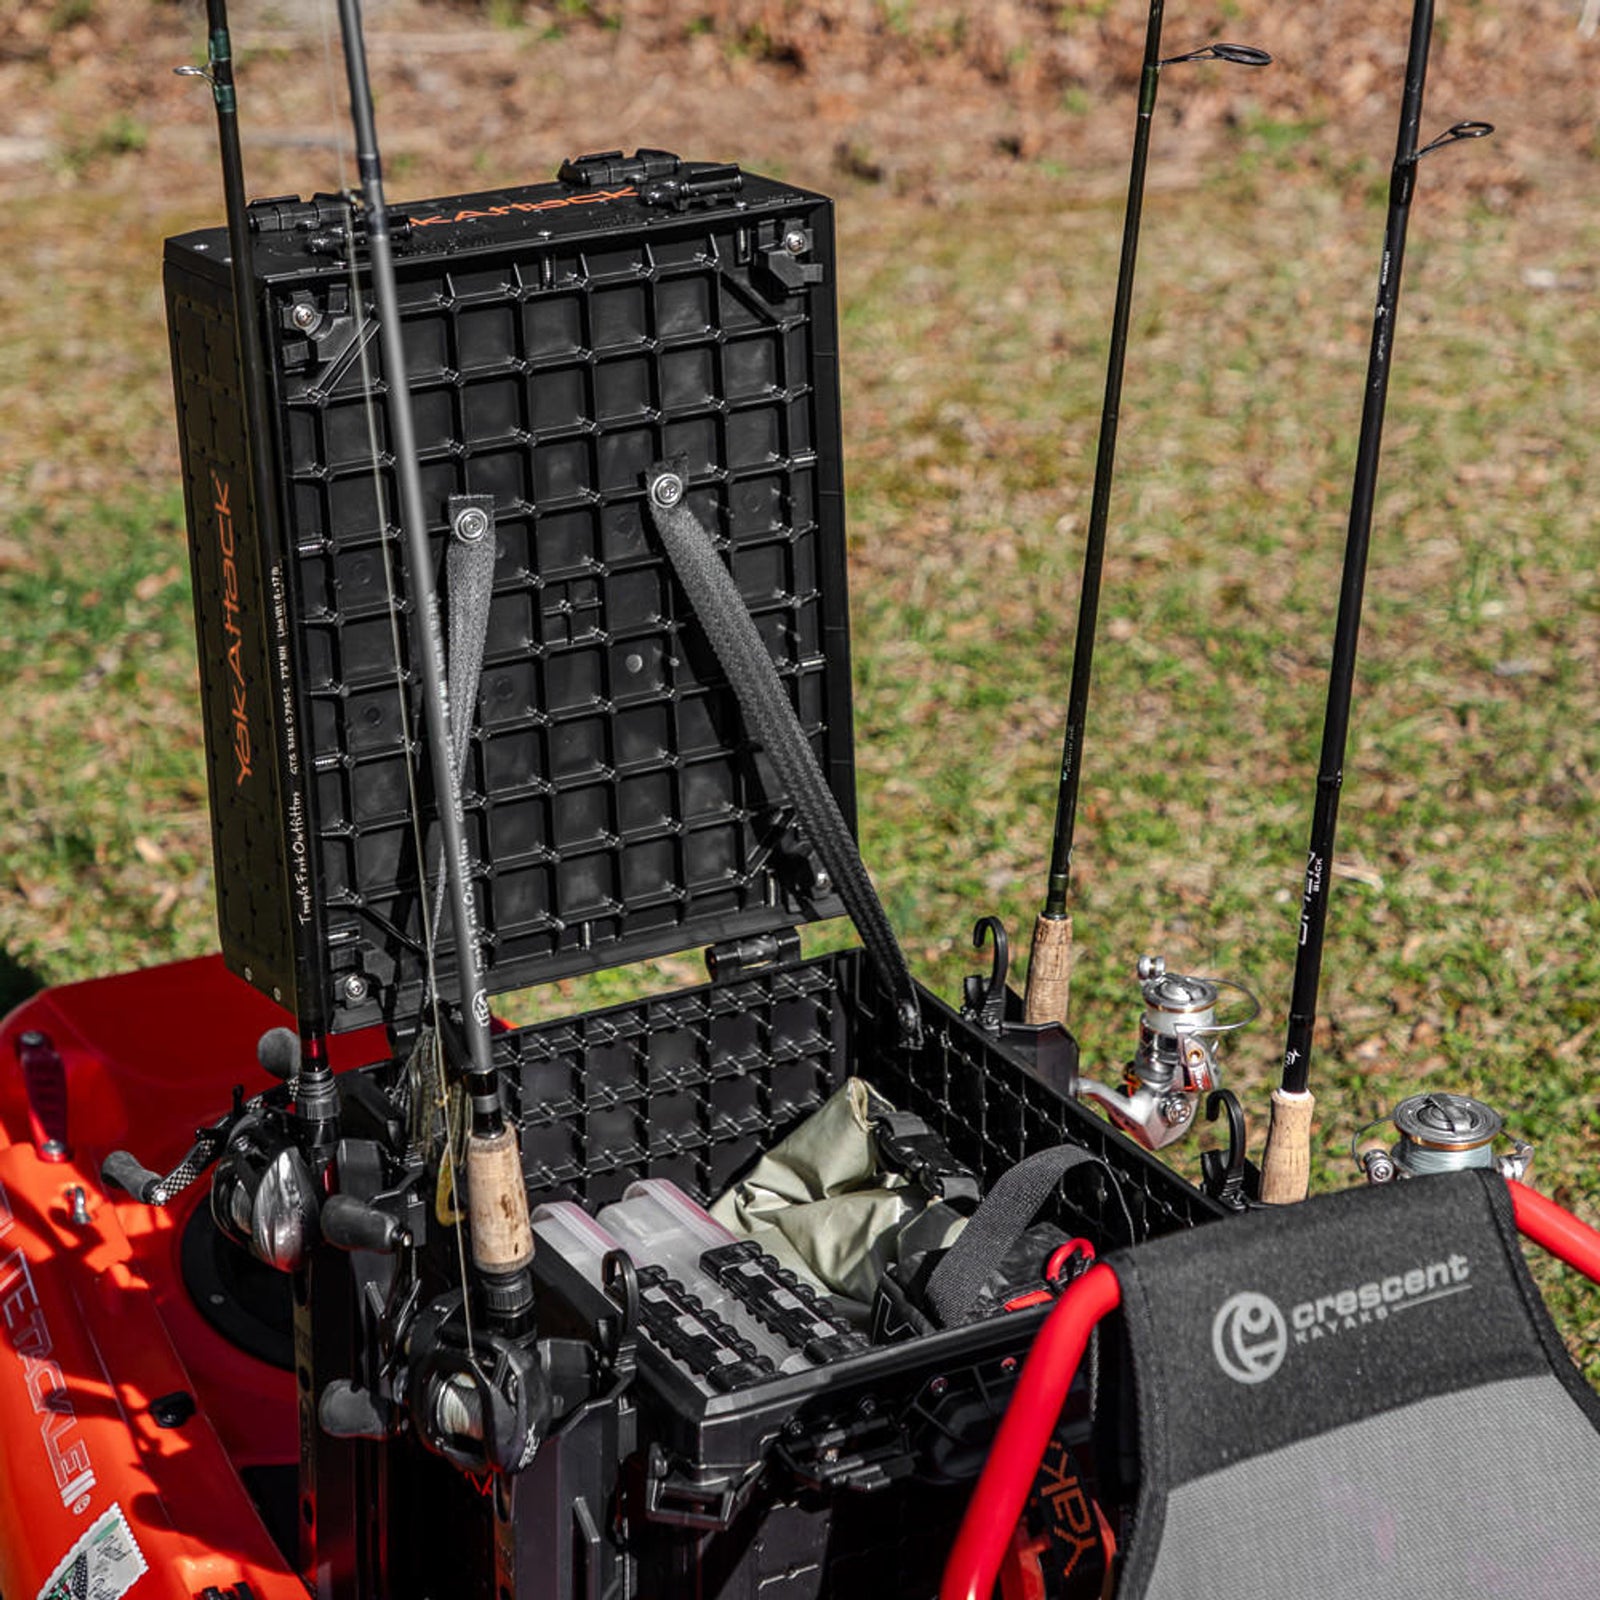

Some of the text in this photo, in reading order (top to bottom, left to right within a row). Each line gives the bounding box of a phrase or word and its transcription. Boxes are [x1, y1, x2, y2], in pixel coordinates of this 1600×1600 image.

[296, 885, 312, 926] Temple
[1291, 1252, 1470, 1331] crescent
[1293, 1304, 1389, 1346] KAYAKS
